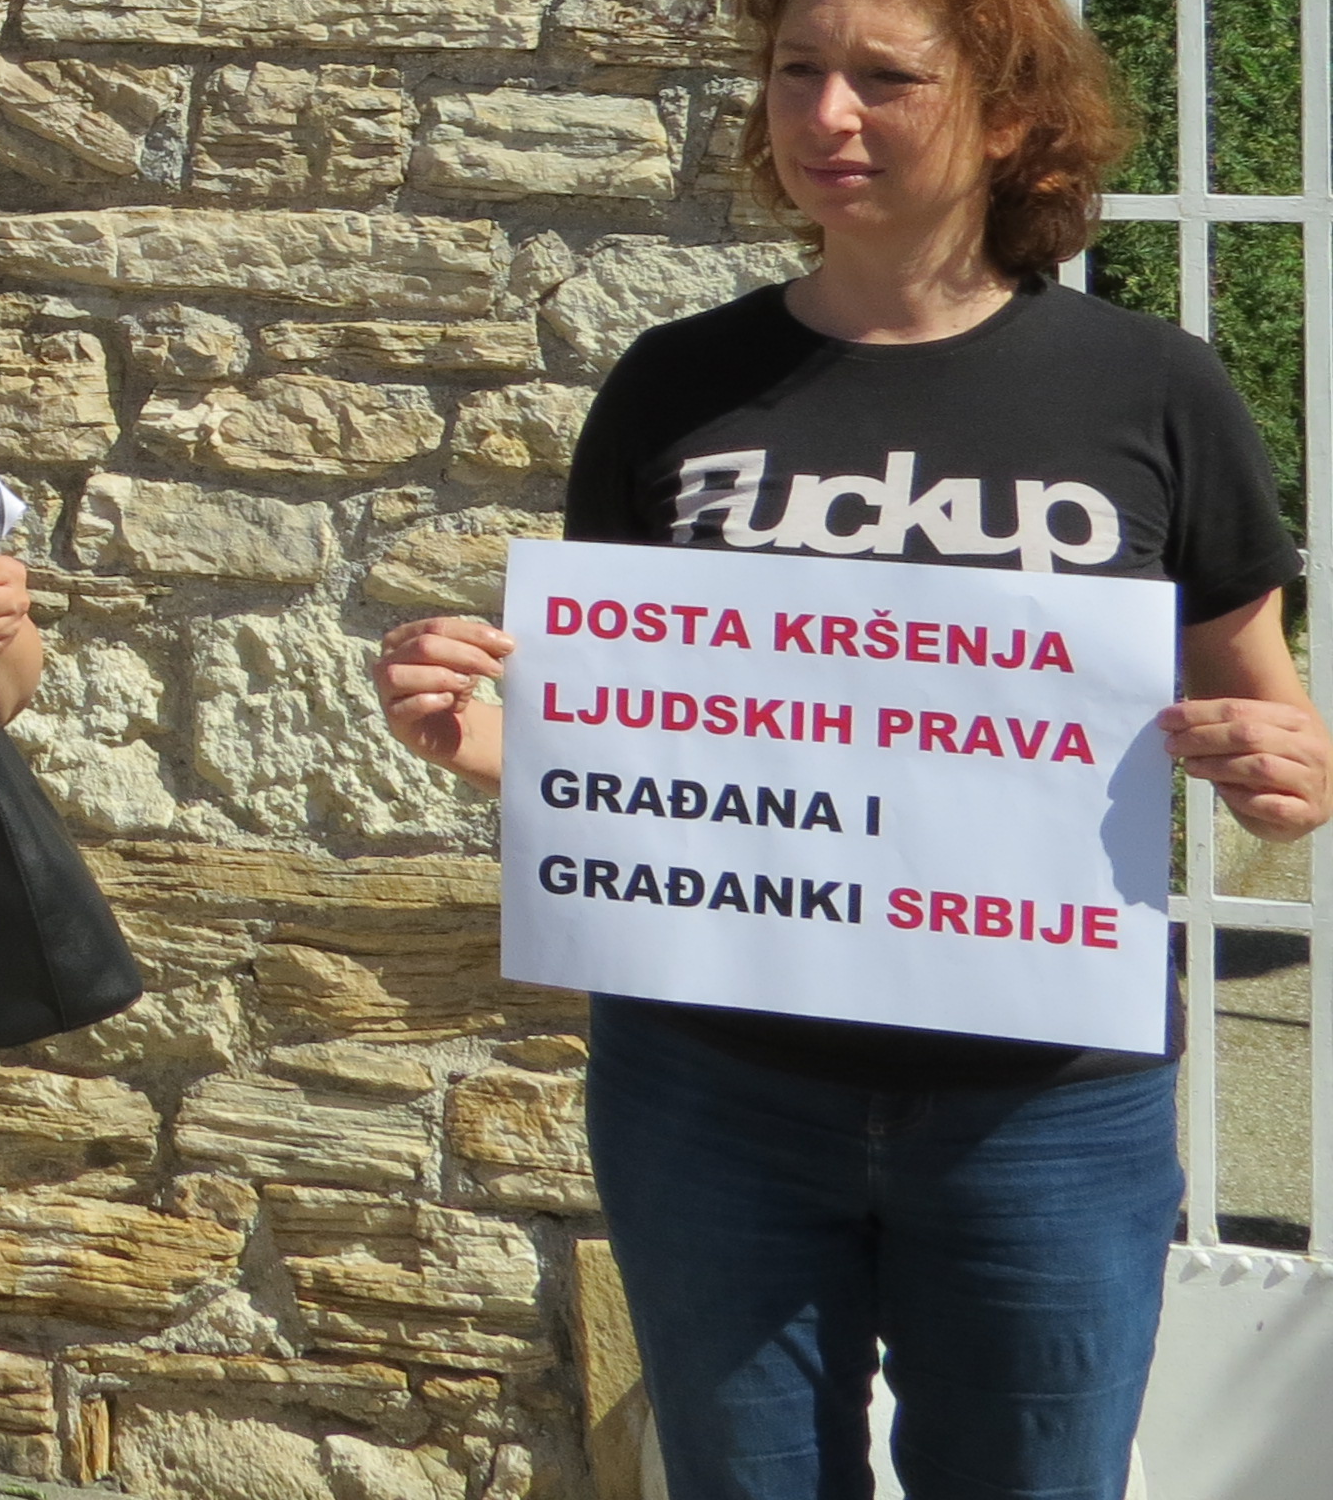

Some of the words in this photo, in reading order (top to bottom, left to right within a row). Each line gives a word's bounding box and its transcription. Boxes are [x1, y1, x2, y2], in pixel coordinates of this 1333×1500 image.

[545, 595, 751, 650] DOSTA
[773, 610, 1074, 674] KRŠENJA
[542, 682, 853, 745] LJUDSKIH
[877, 707, 1095, 764] PRAVA
[539, 768, 843, 834] GRAĐANA
[866, 795, 881, 836] I
[538, 854, 863, 924] GRAĐANKI
[886, 887, 1119, 950] SRBIJE
